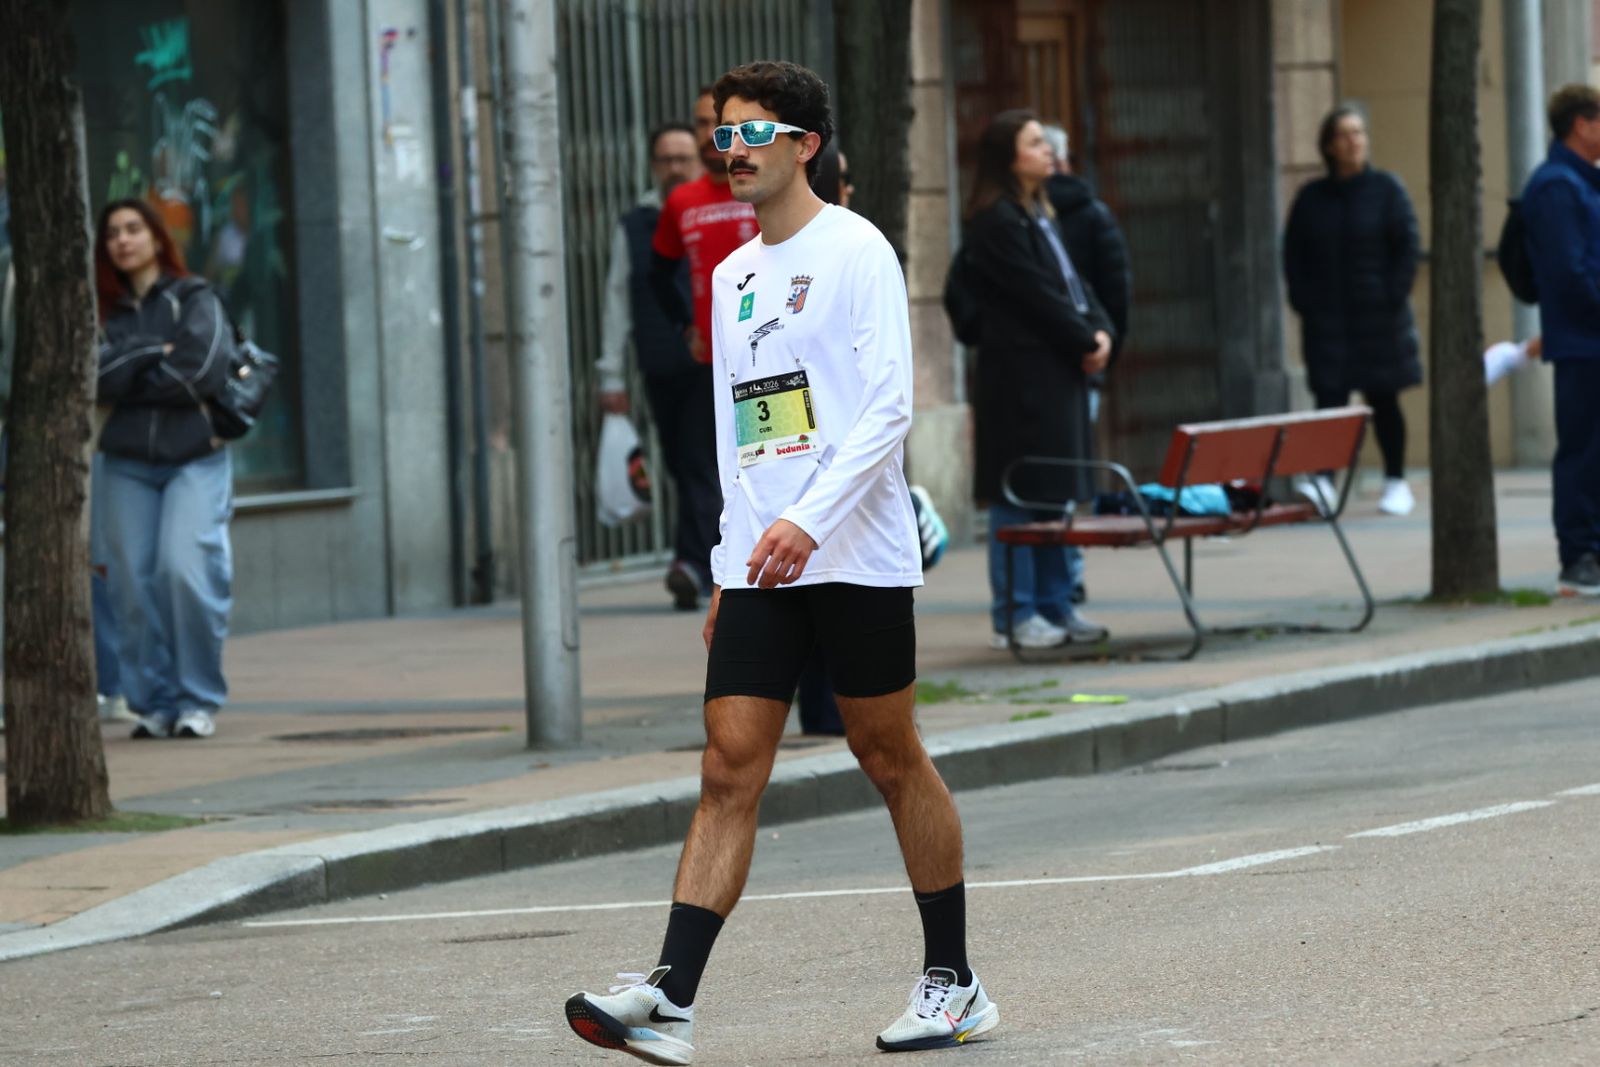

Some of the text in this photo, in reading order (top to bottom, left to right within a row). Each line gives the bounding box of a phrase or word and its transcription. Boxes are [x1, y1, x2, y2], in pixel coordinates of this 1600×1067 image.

[763, 380, 779, 390] 2026
[757, 400, 770, 422] 3
[776, 443, 811, 454] bedunia
